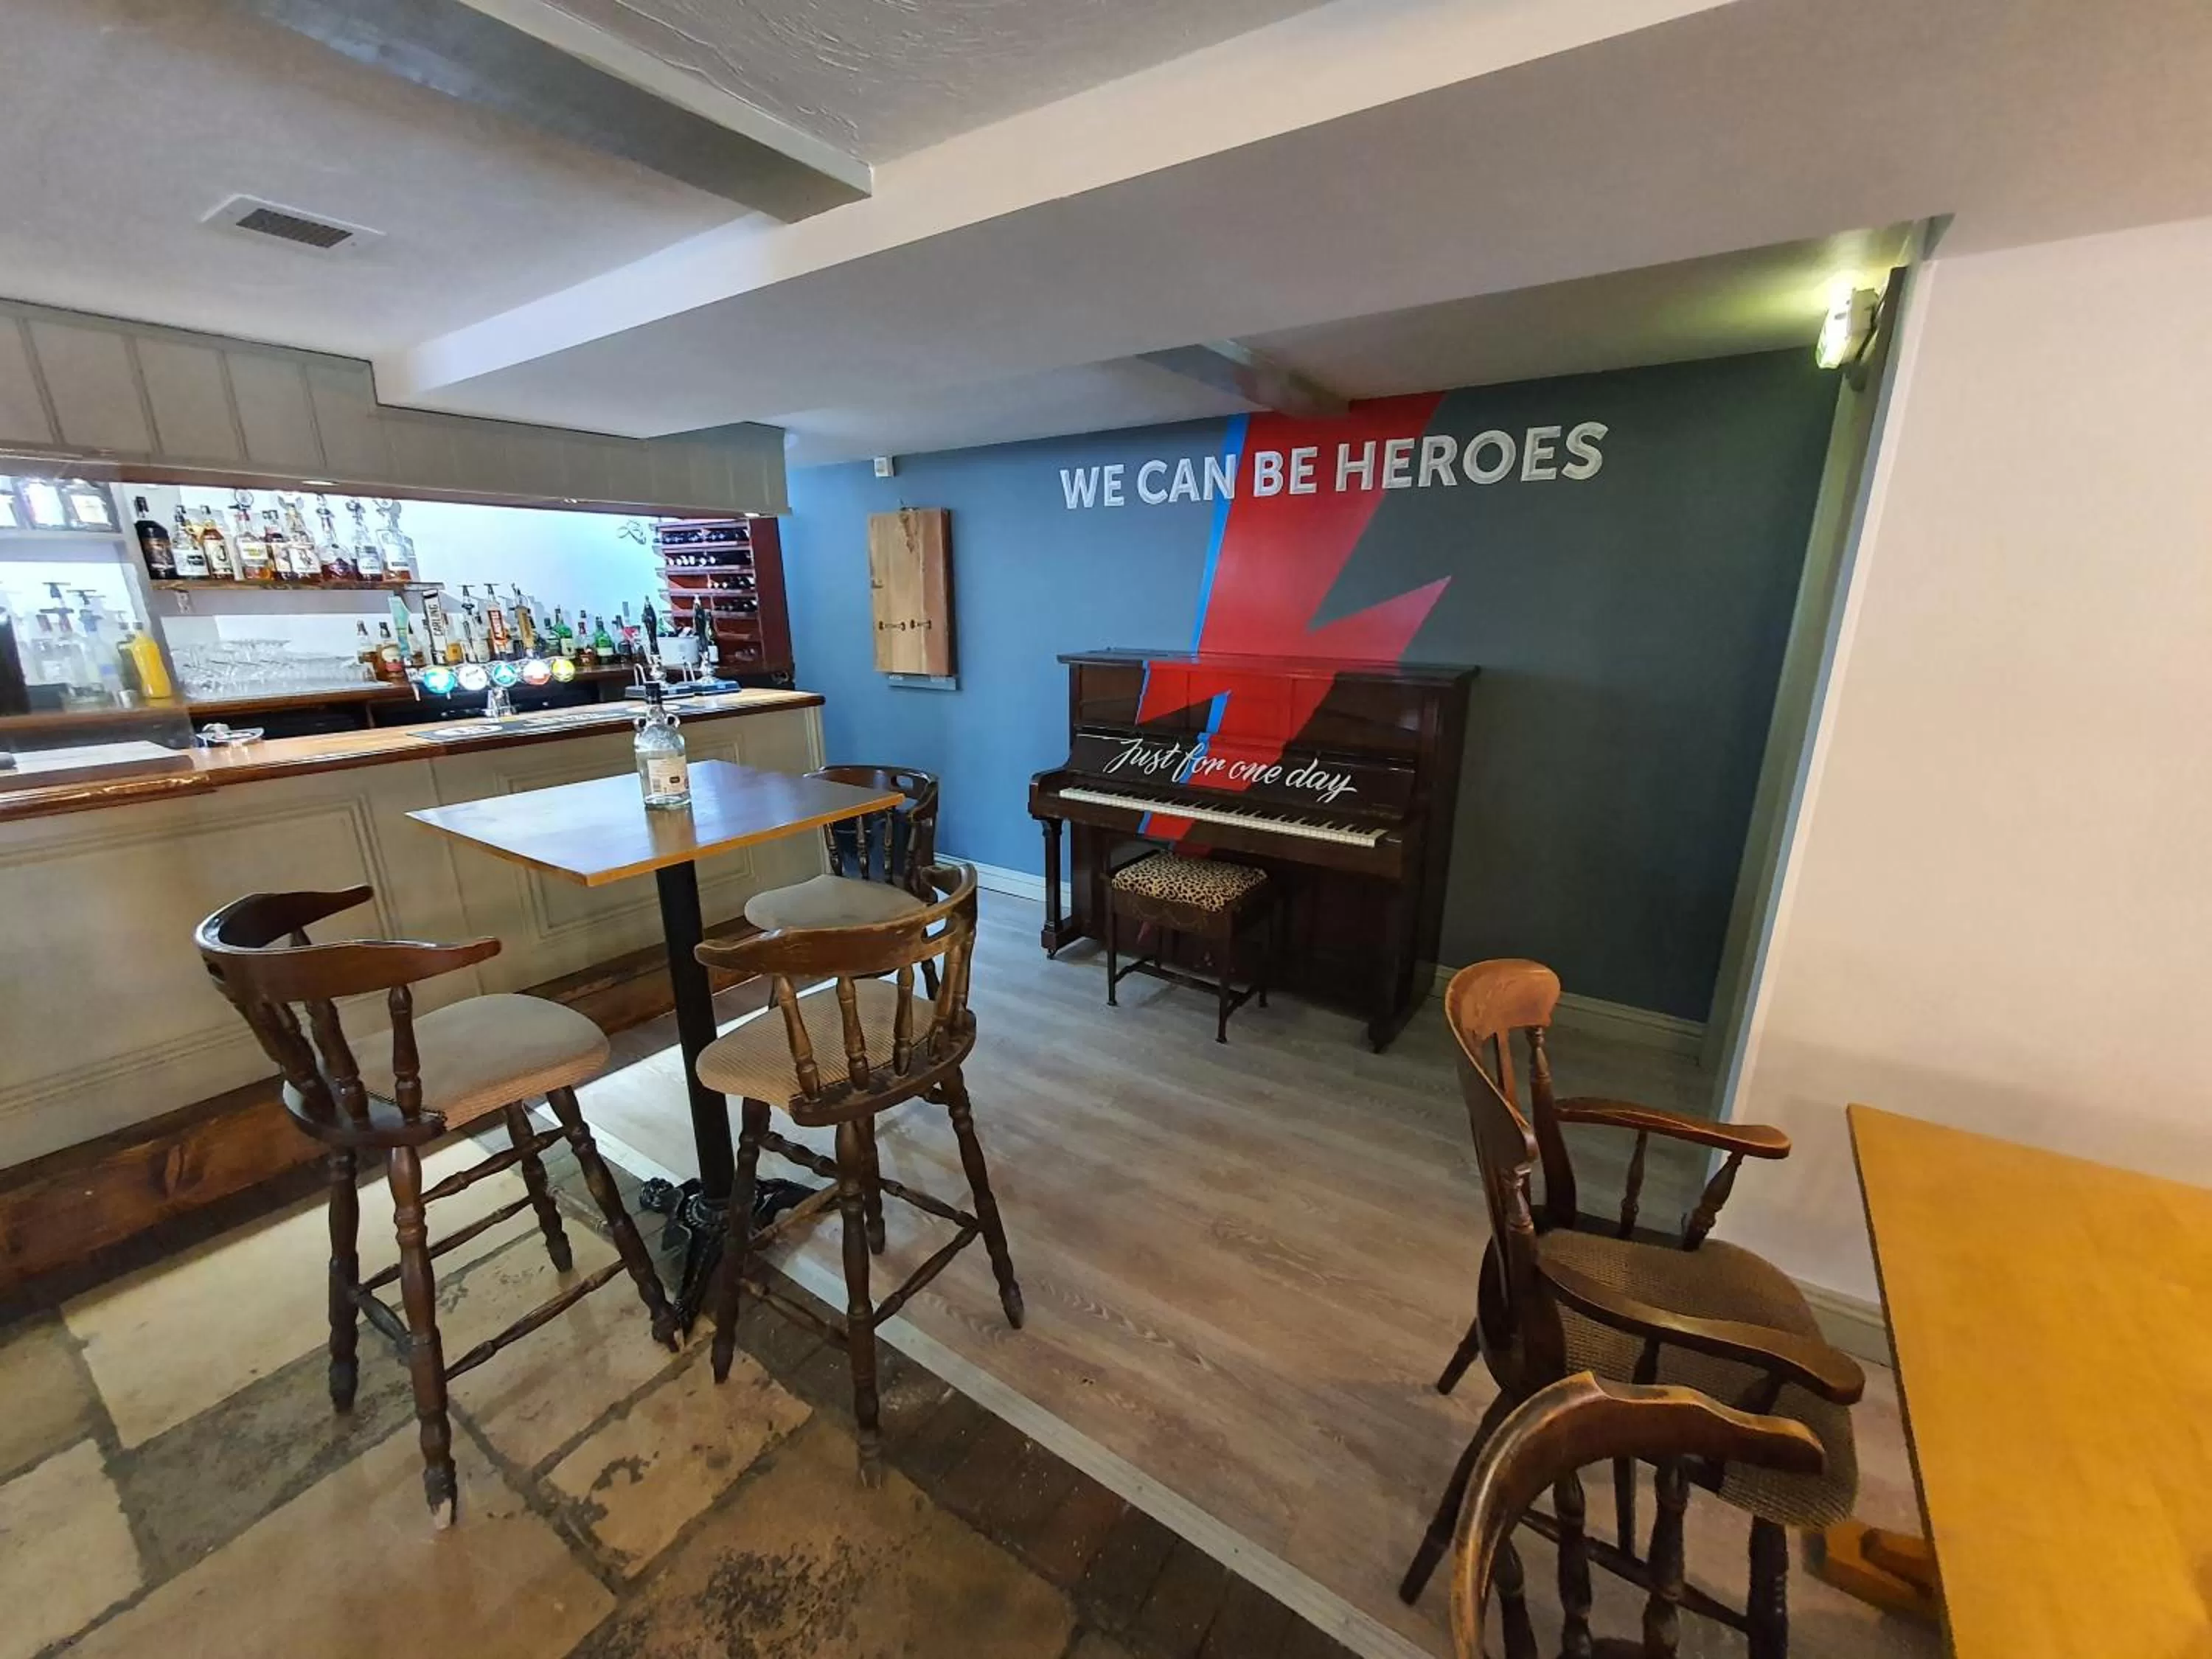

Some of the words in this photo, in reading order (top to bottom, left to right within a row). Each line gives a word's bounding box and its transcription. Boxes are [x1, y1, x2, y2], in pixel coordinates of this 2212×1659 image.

[1060, 464, 1124, 509] WE
[1136, 453, 1237, 504] CAN
[1253, 446, 1318, 497] BE
[1335, 421, 1609, 492] HEROES
[429, 603, 443, 636] CARLING
[1103, 737, 1180, 775] Just
[1172, 742, 1225, 783] for
[1230, 759, 1282, 782] one
[1285, 757, 1357, 803] day
